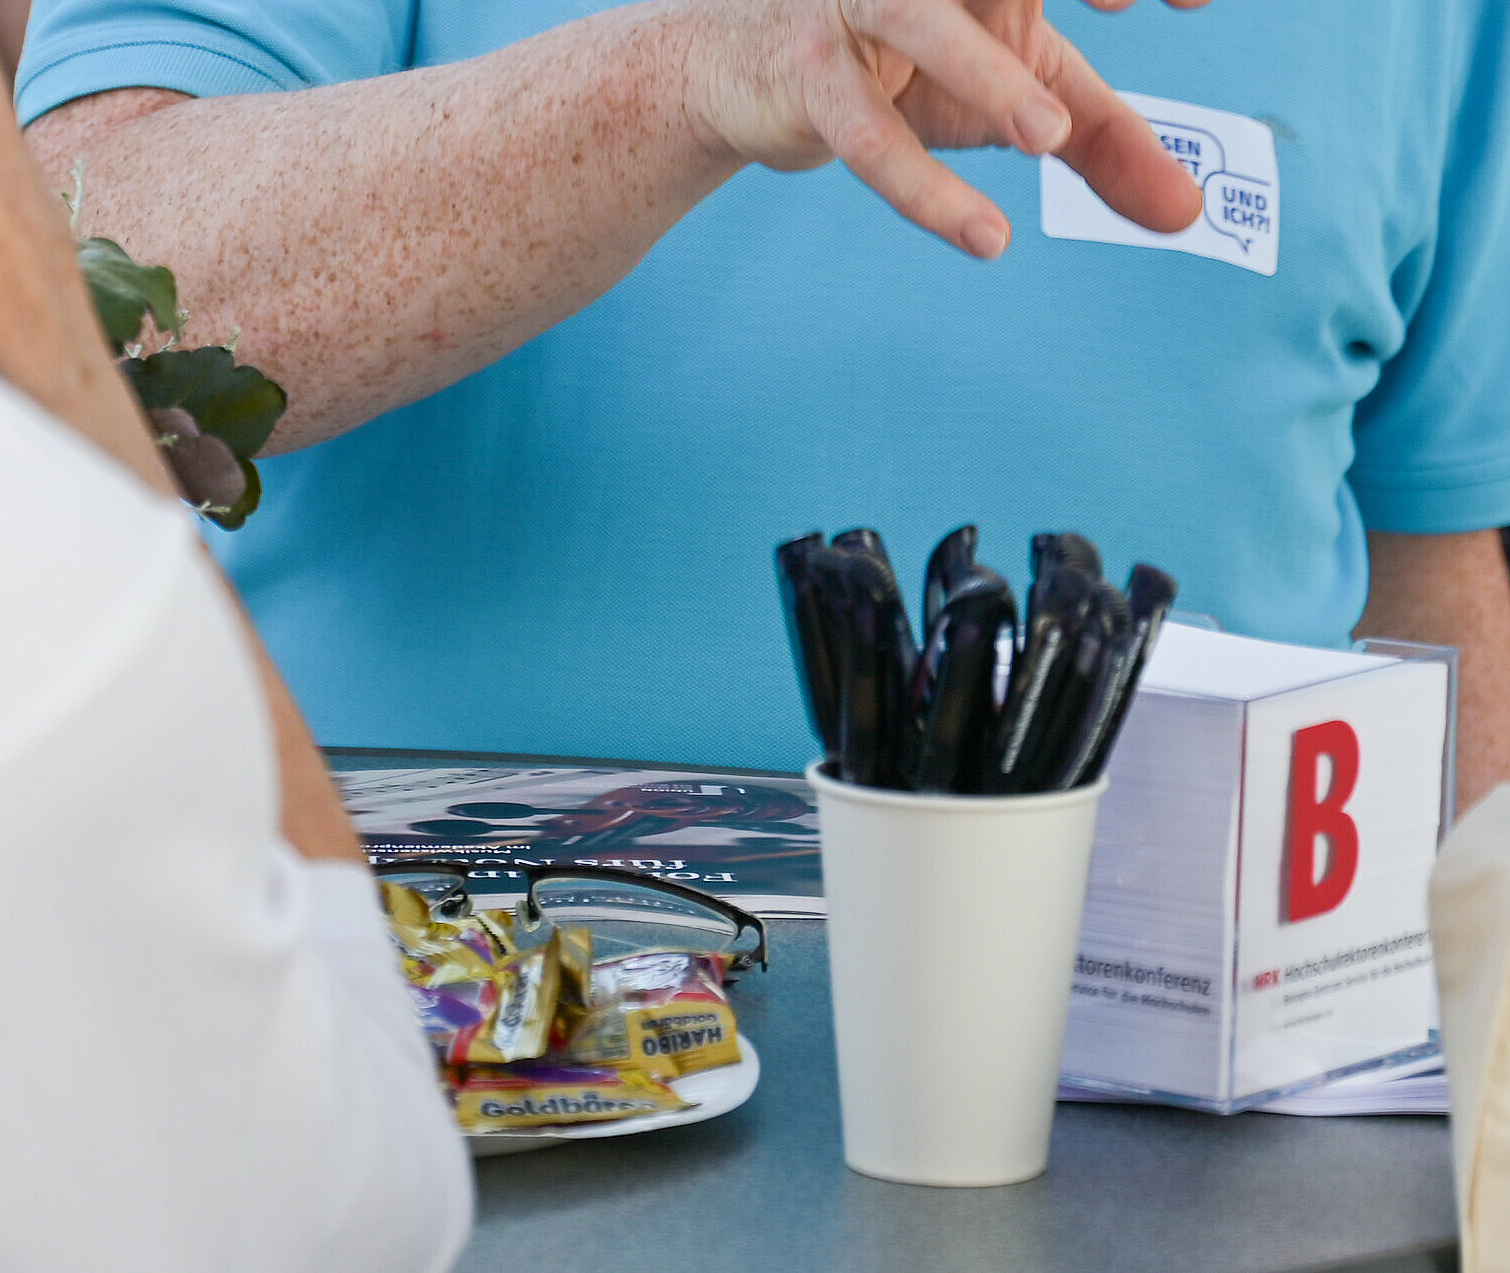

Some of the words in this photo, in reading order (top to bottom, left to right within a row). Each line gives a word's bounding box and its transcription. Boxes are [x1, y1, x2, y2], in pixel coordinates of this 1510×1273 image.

[1223, 186, 1267, 211] UND
[1224, 206, 1270, 234] ICH?!
[1288, 720, 1360, 924] B
[573, 858, 686, 870] fürs
[1075, 952, 1211, 997] torenkonferenz
[641, 1026, 724, 1058] HARIBO
